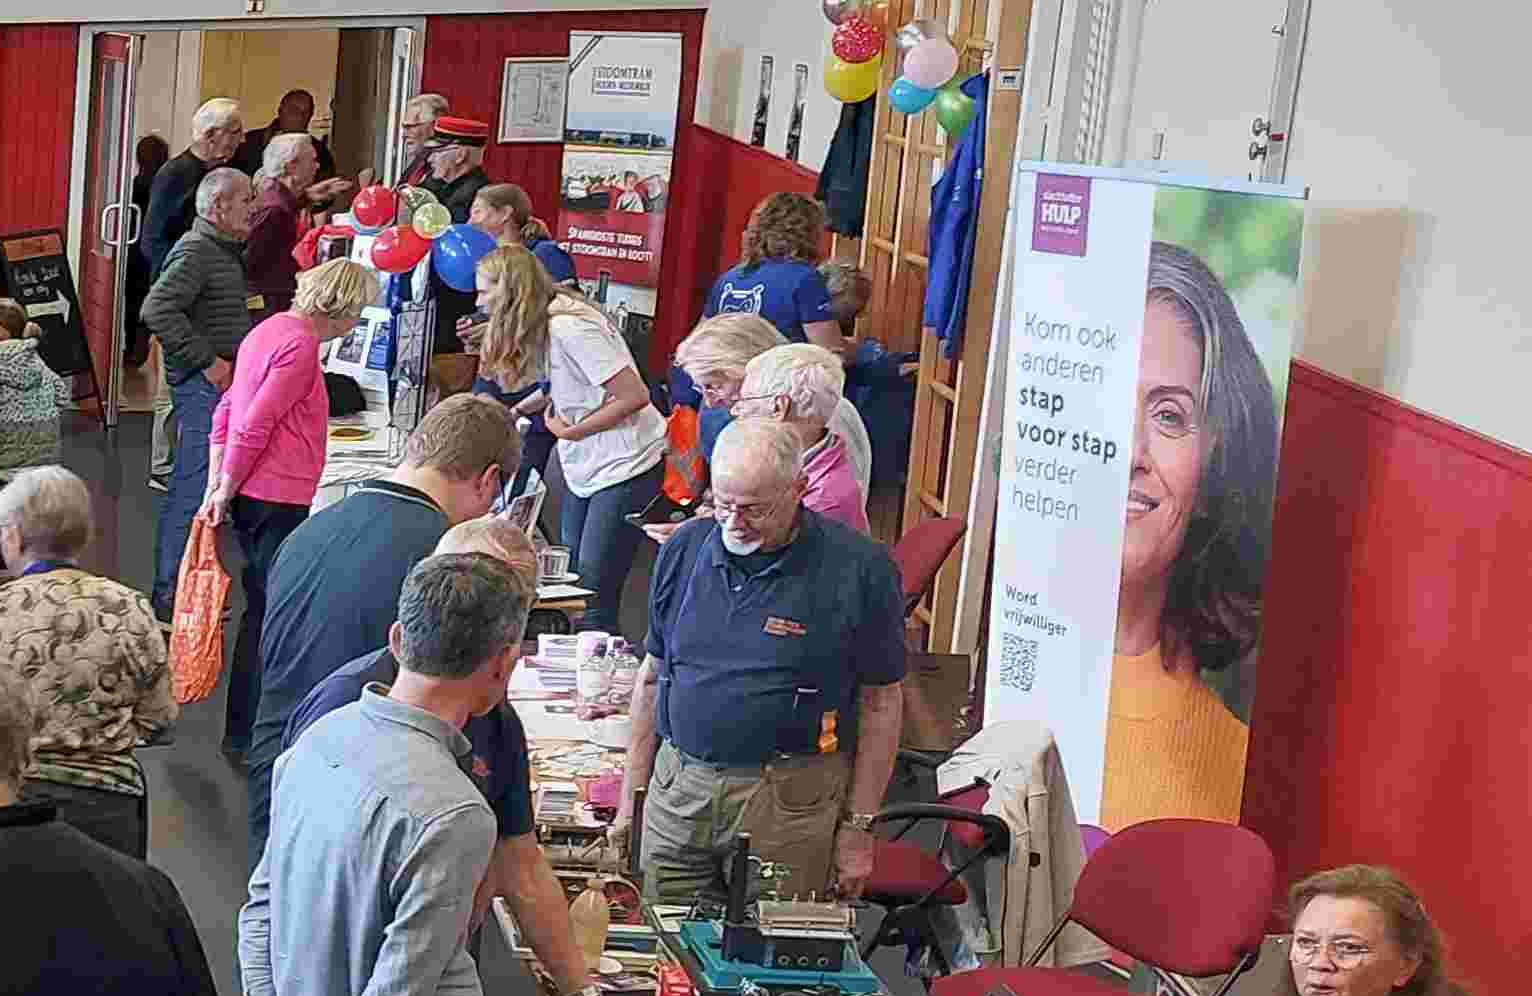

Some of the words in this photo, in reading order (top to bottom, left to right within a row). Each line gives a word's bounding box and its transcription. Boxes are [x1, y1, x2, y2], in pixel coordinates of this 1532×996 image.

[1041, 203, 1081, 224] HULP
[1024, 311, 1071, 342] Kom
[1077, 323, 1117, 350] ook
[1021, 351, 1104, 384] anderen
[1019, 386, 1064, 417] stap
[1017, 421, 1066, 447] voor
[1072, 430, 1117, 464] stap
[1015, 456, 1078, 485] verder
[1012, 485, 1079, 521] helpen
[1006, 584, 1038, 606] Word
[1004, 608, 1068, 637] vrijwilliger
